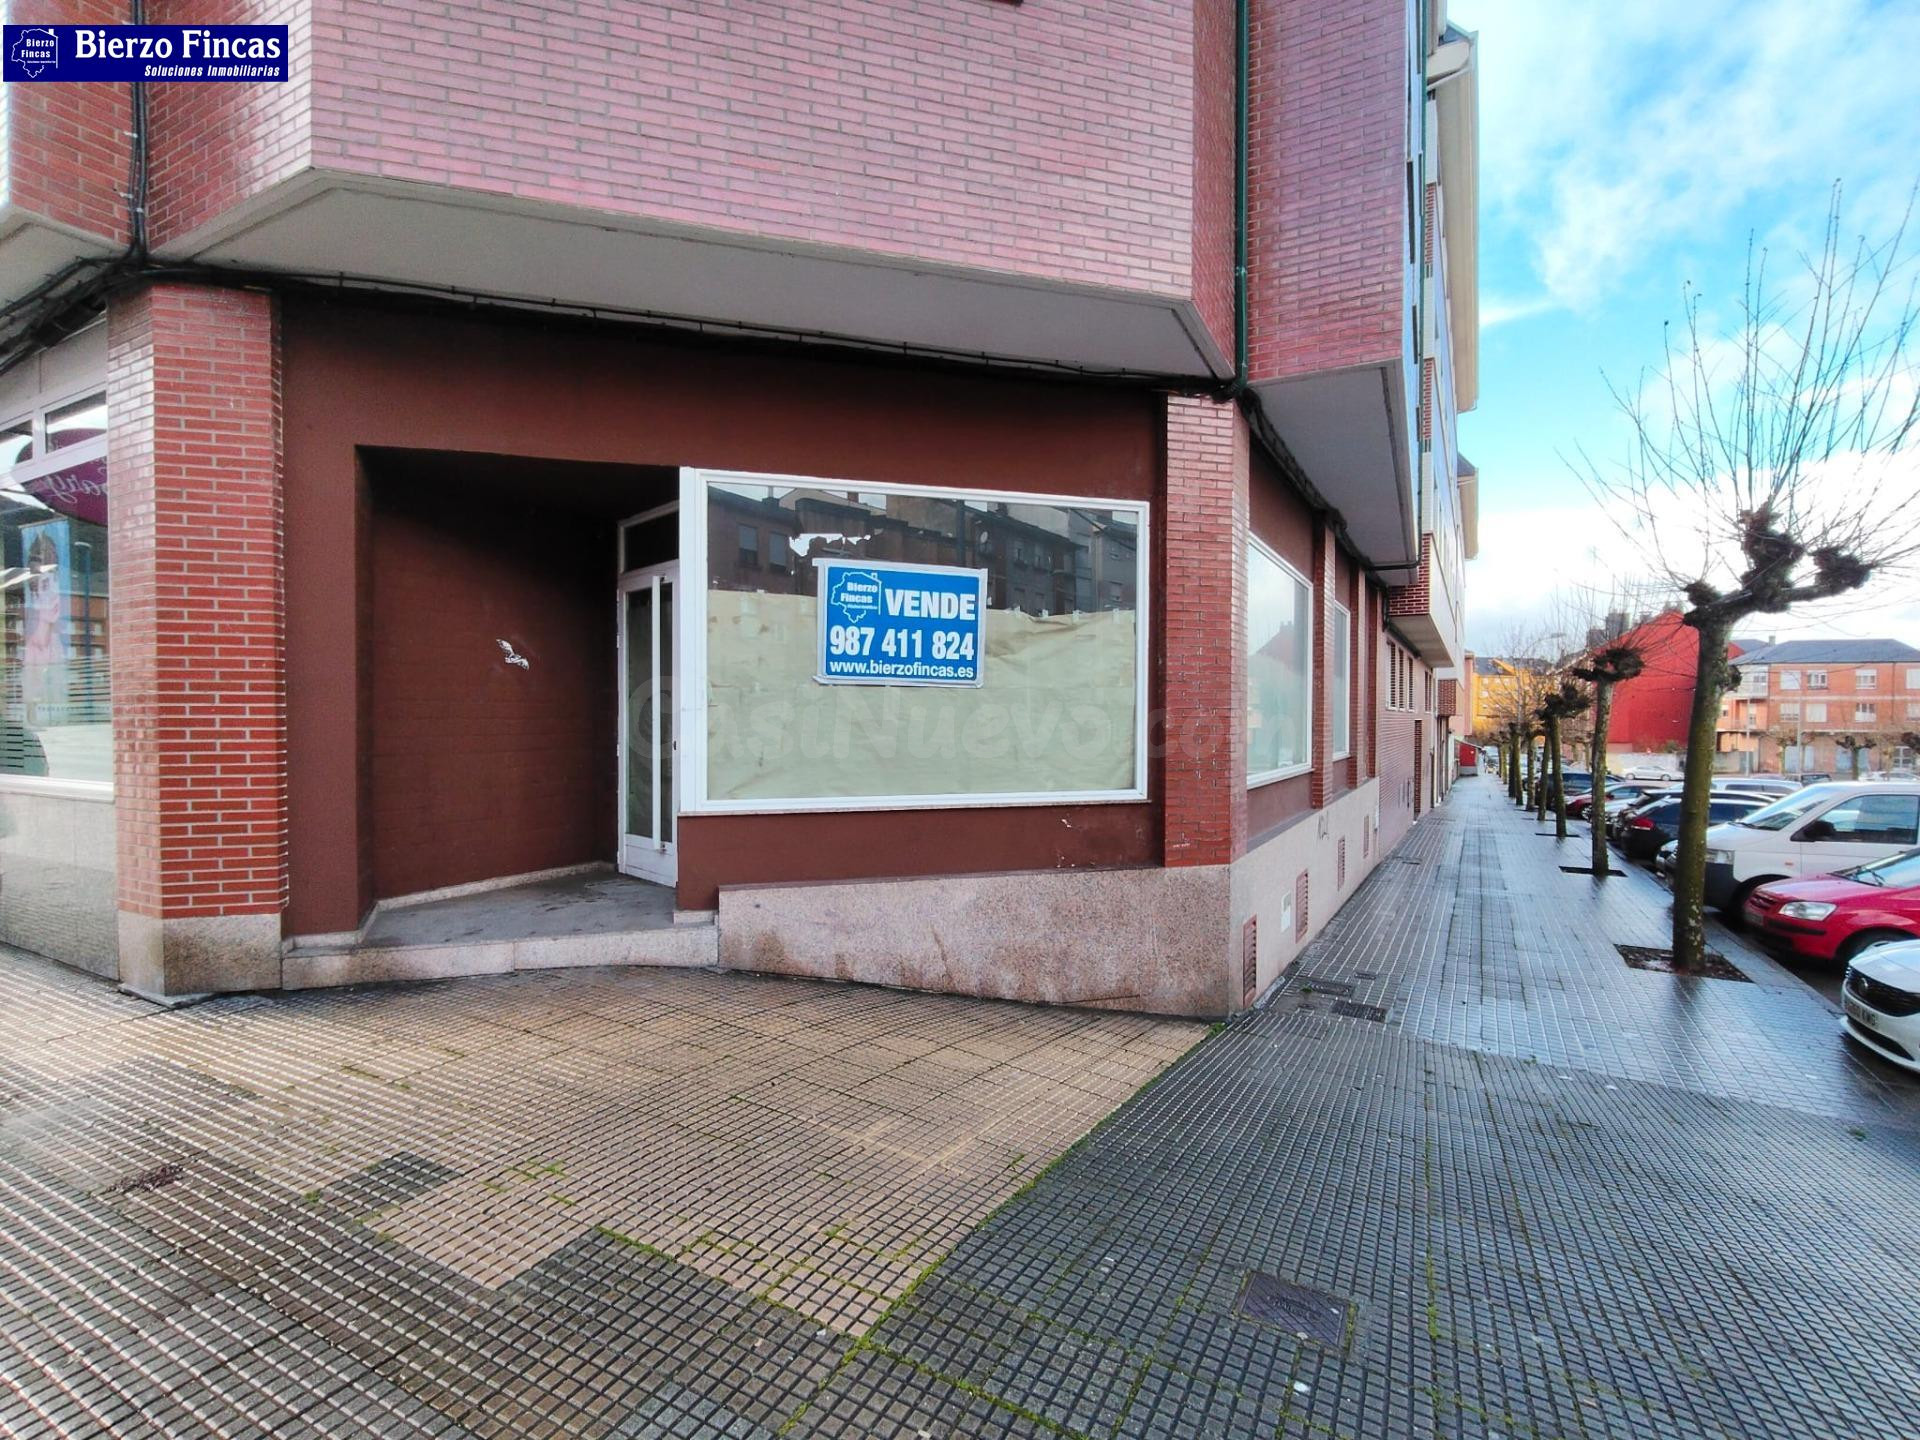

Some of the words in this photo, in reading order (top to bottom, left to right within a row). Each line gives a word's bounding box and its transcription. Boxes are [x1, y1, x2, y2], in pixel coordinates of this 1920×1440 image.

[847, 581, 878, 593] Bierzo
[840, 594, 873, 604] Fincas
[884, 588, 976, 621] VENDE
[830, 625, 876, 656] 987
[881, 628, 923, 658] 411
[931, 630, 975, 661] 824
[829, 659, 974, 678] www.bierzofincas.es
